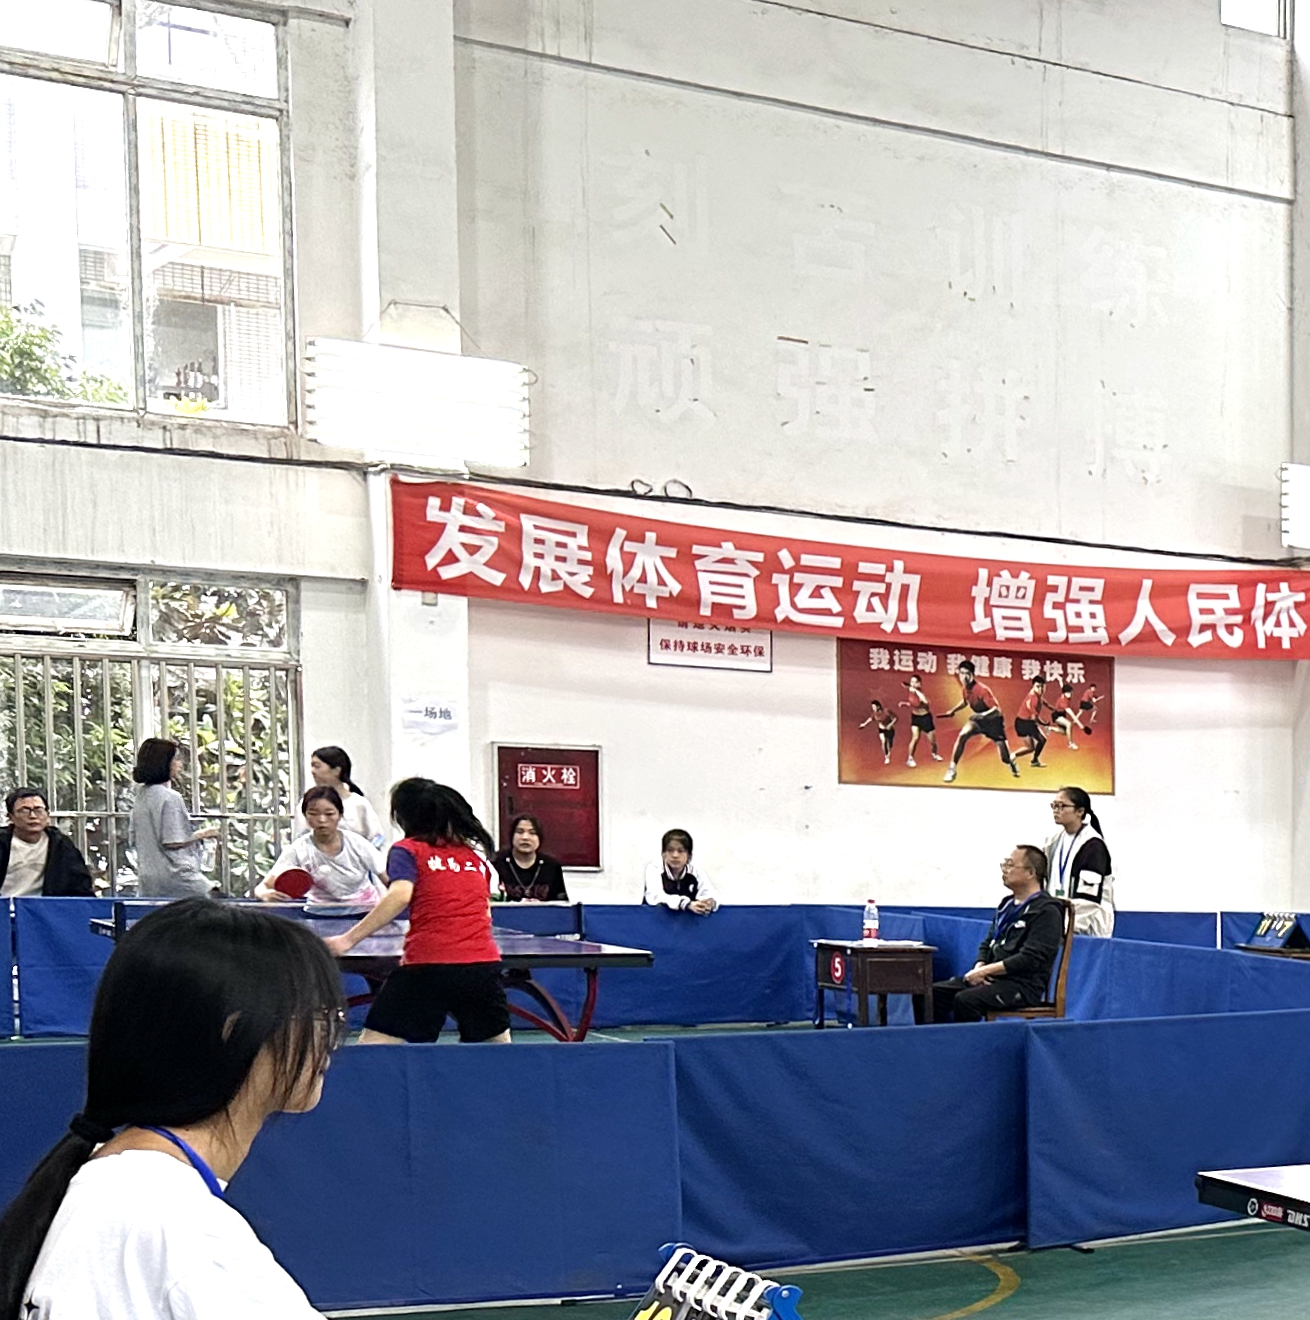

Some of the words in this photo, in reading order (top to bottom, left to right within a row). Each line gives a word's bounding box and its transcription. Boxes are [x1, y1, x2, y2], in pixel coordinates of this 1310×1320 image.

[424, 495, 921, 636] 发展体育运动
[659, 638, 765, 657] 保持球场安全环保
[869, 648, 937, 673] 我运动
[1021, 659, 1086, 685] 我快乐
[521, 767, 577, 785] 消火栓
[834, 958, 842, 976] 5
